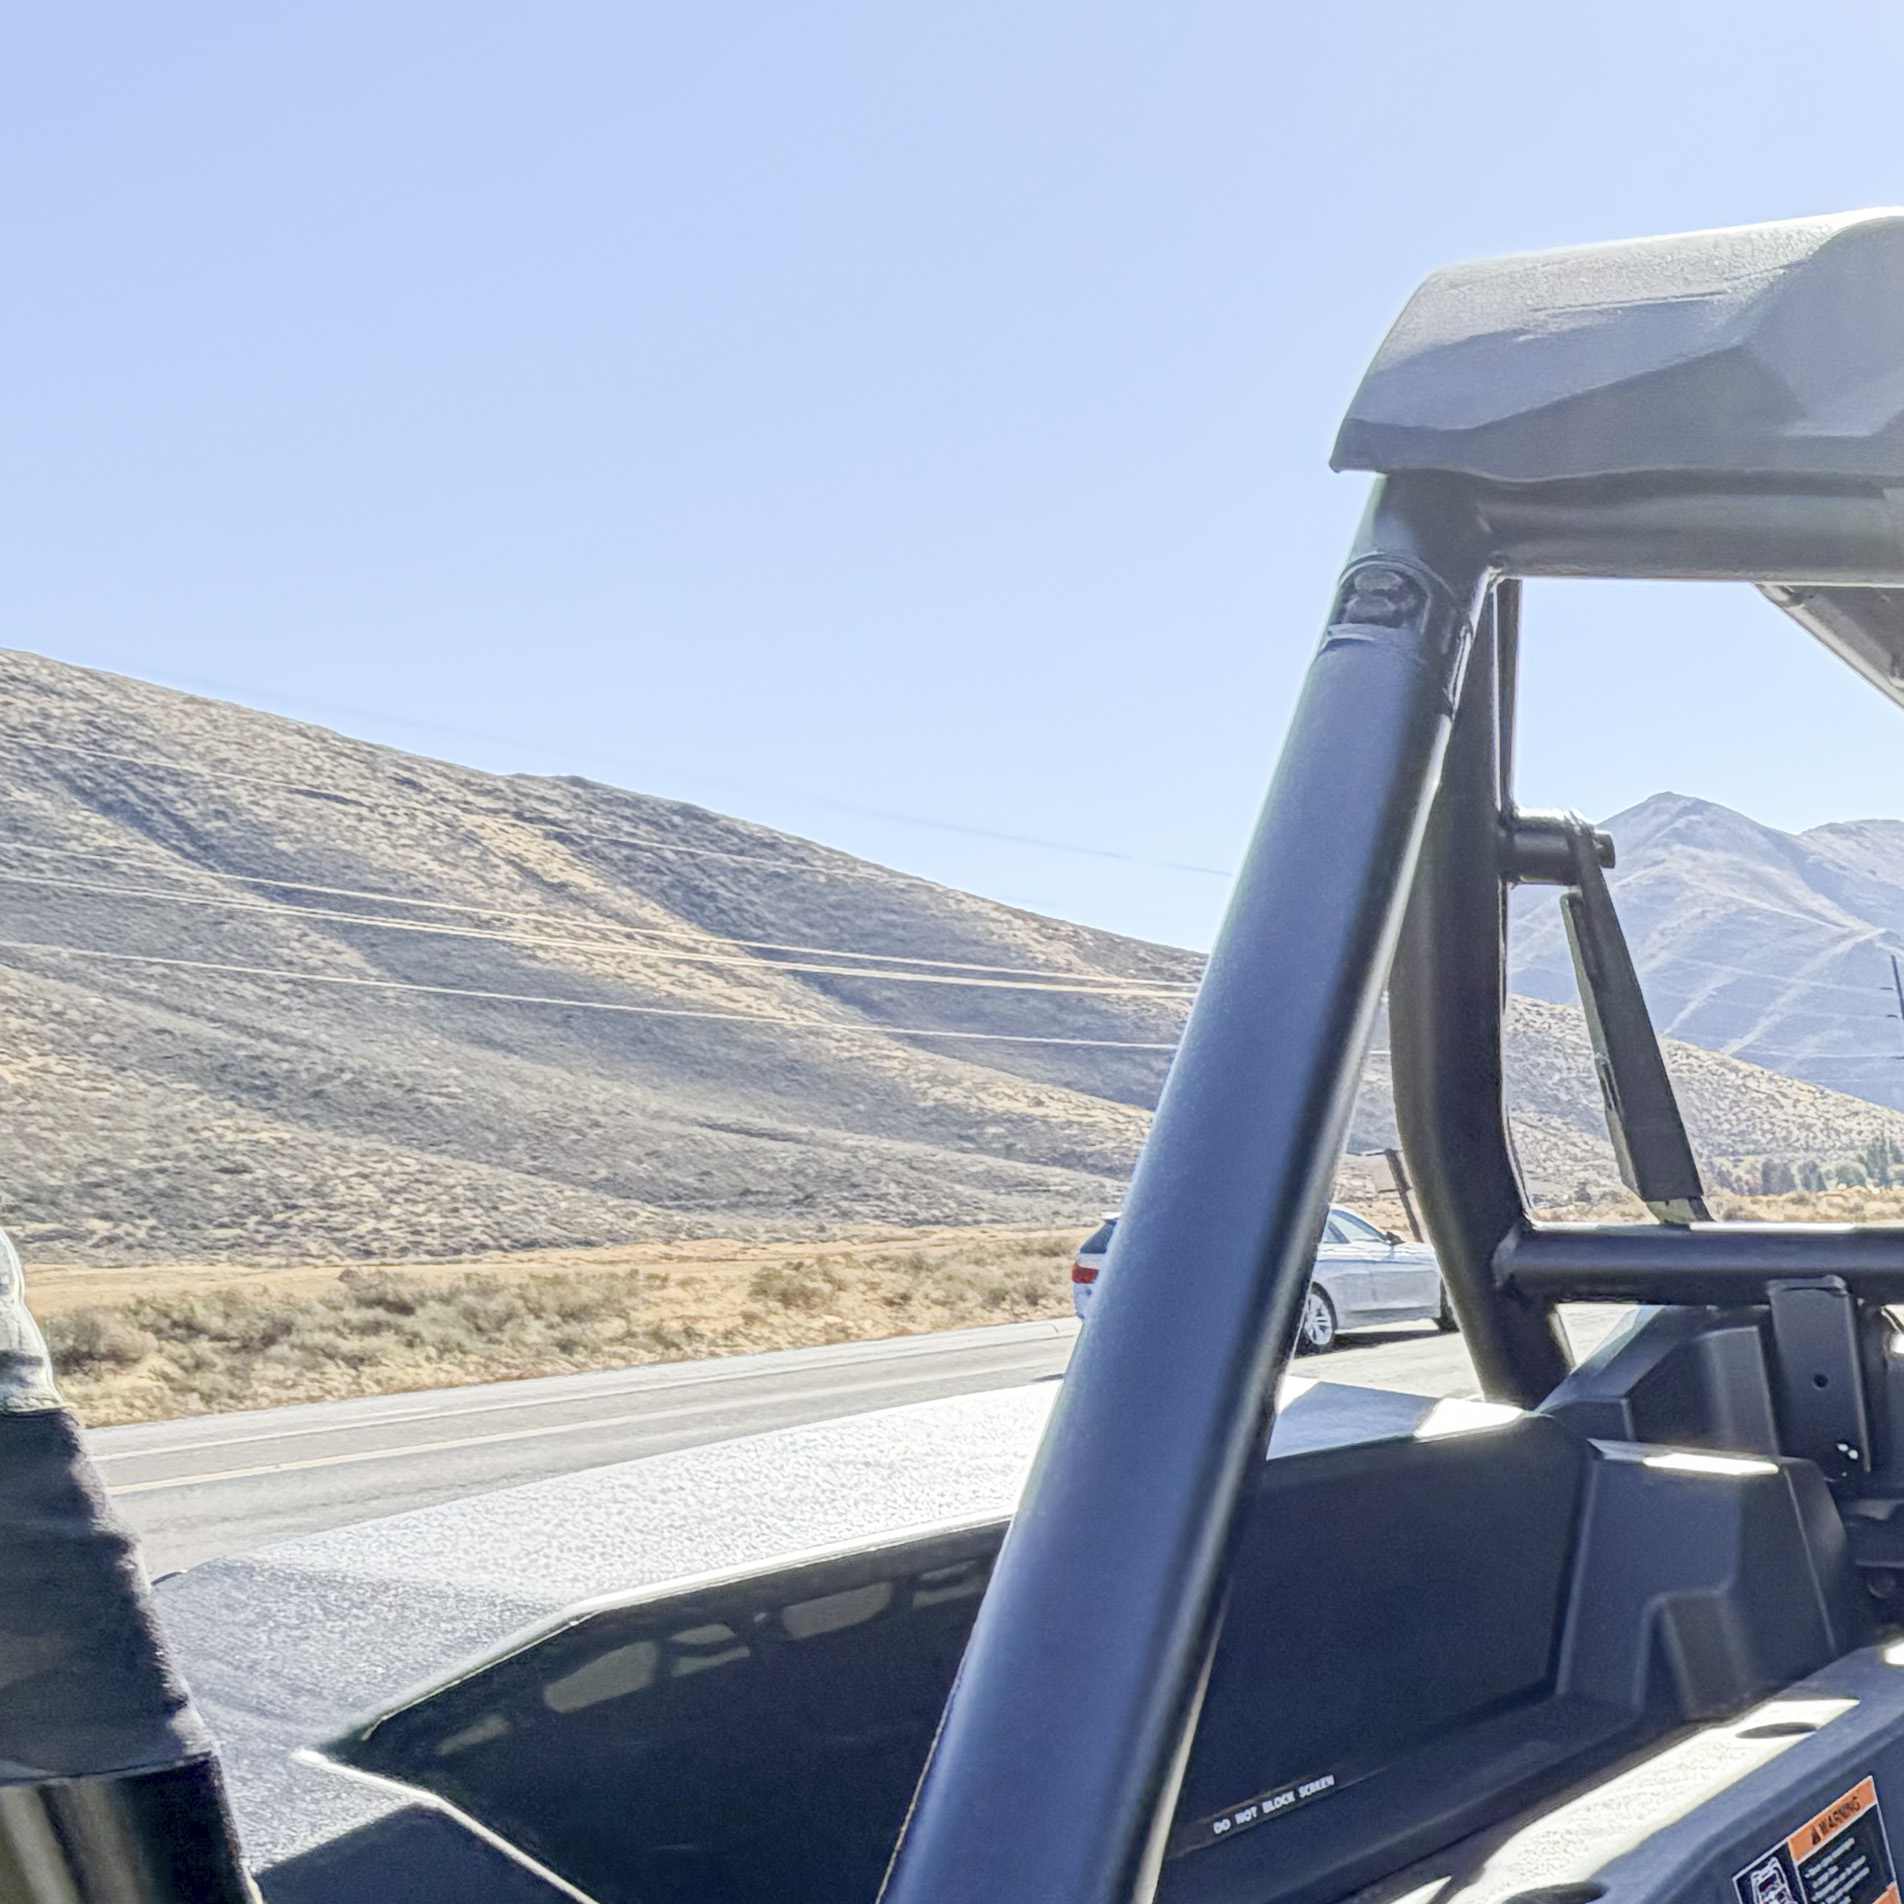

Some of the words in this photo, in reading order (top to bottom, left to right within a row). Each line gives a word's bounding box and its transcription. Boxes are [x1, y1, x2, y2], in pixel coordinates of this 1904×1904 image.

[1213, 1818, 1231, 1835] DO
[1235, 1806, 1257, 1824] NOT
[1262, 1790, 1297, 1814] BLOCK
[1298, 1774, 1335, 1799] SCREEN
[1817, 1795, 1861, 1837] WARNING
